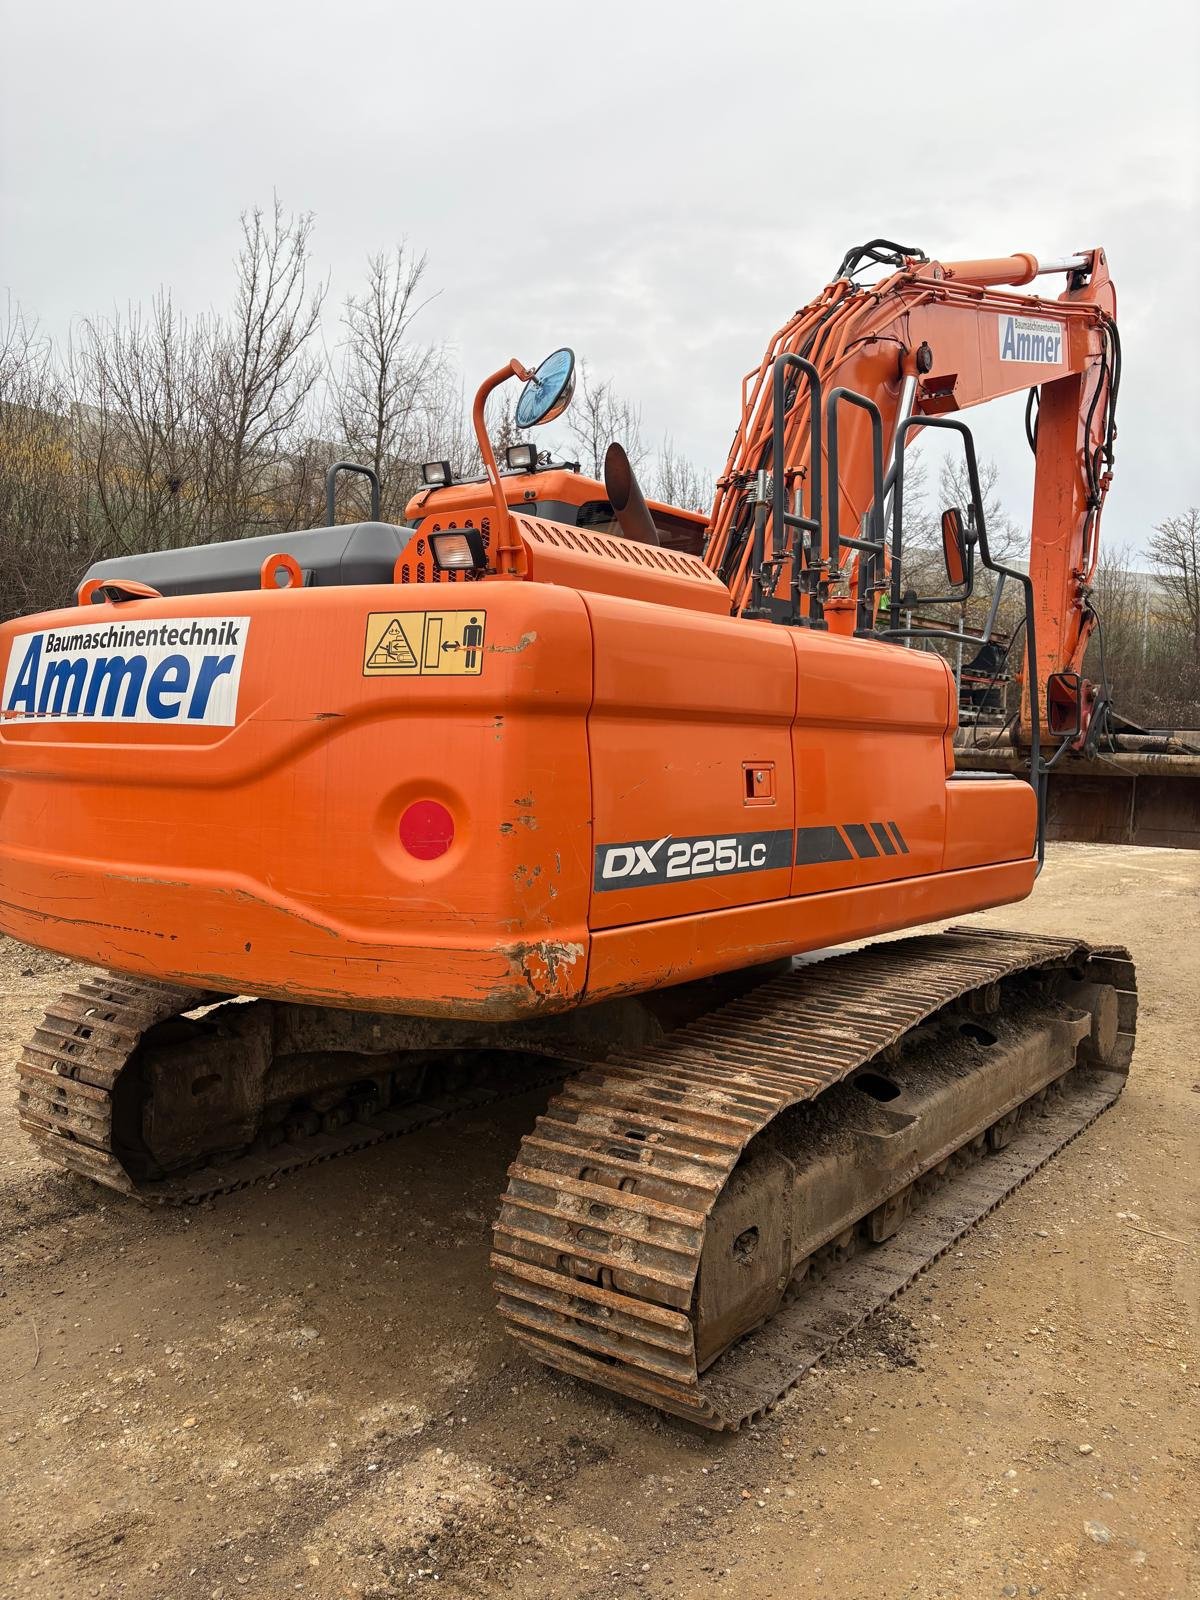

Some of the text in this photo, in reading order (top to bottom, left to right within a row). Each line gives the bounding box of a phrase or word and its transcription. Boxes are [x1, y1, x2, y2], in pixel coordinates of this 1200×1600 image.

[1002, 317, 1060, 362] Ammer
[45, 622, 240, 653] Baumaschinentechnik
[4, 634, 236, 719] Ammer
